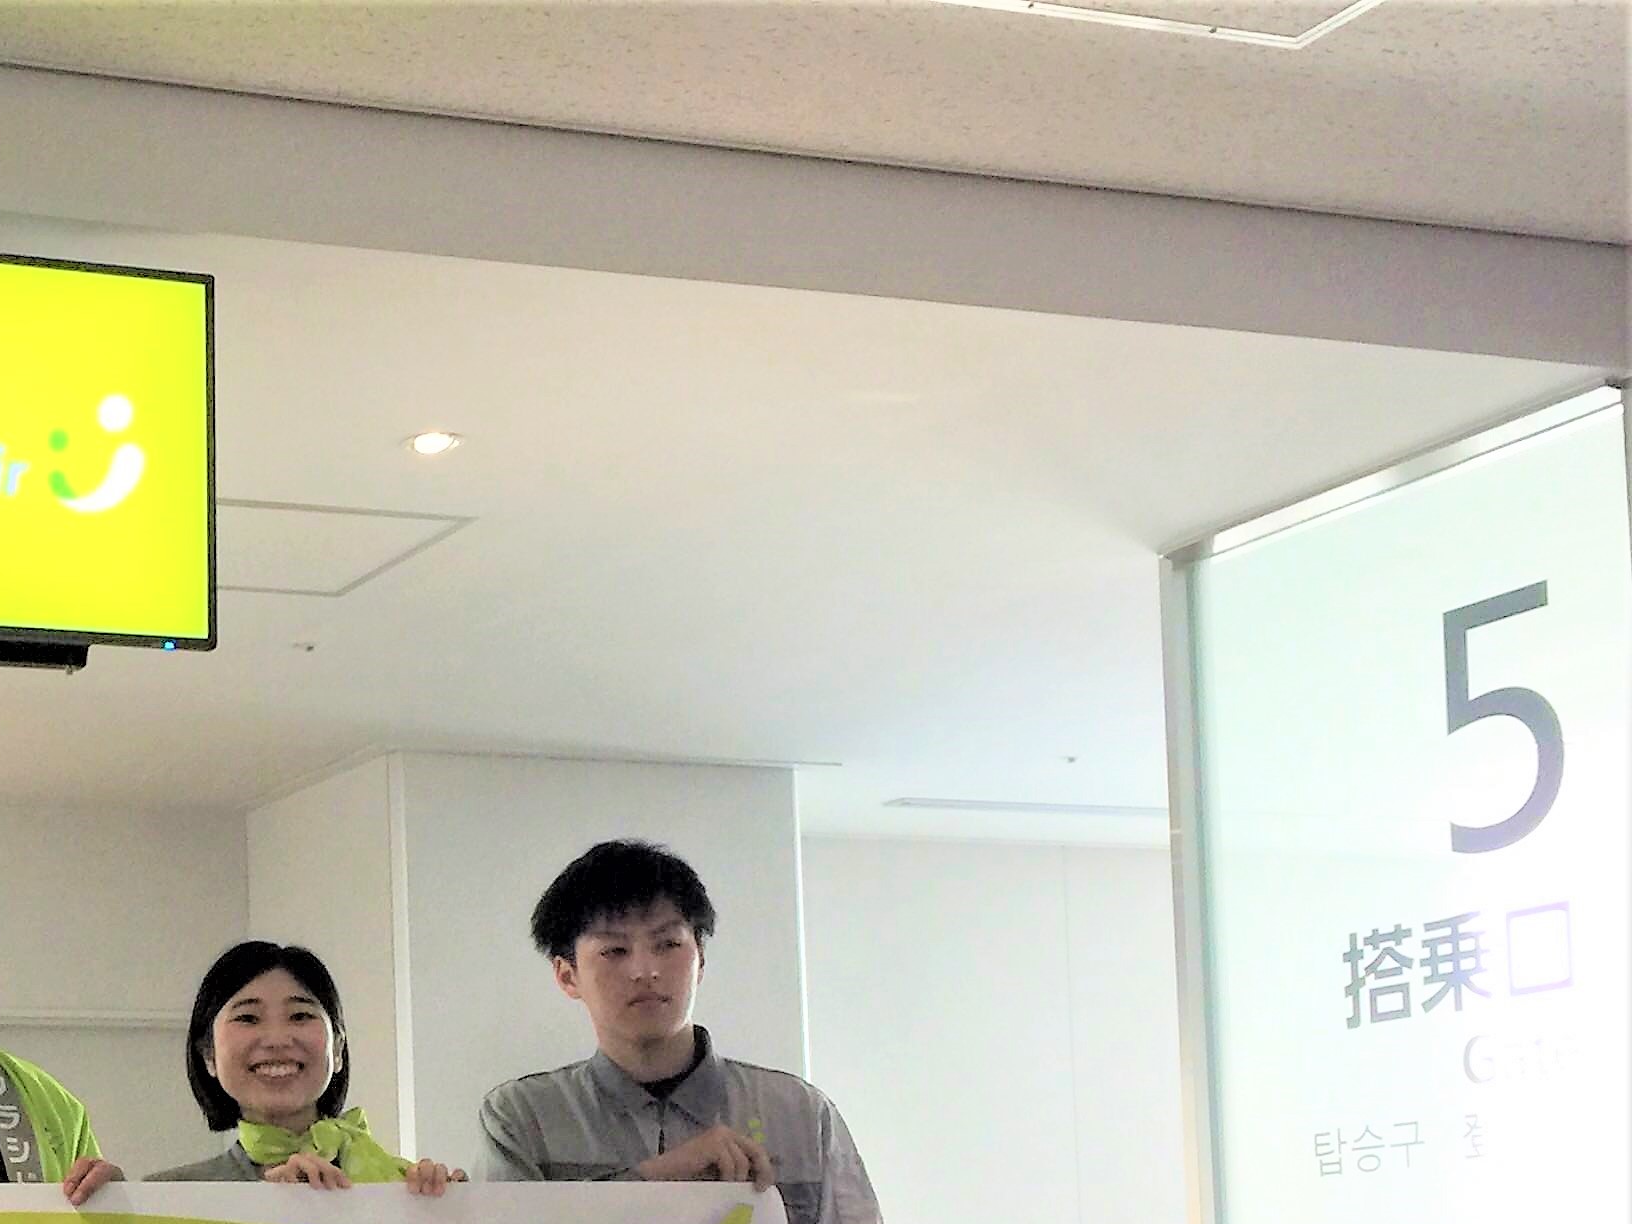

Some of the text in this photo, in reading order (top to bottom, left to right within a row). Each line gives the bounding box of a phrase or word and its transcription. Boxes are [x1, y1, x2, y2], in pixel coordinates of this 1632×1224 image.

[1443, 579, 1565, 854] 5
[1342, 899, 1574, 1030] 搭乗口
[1313, 1119, 1425, 1177] 탑승구
